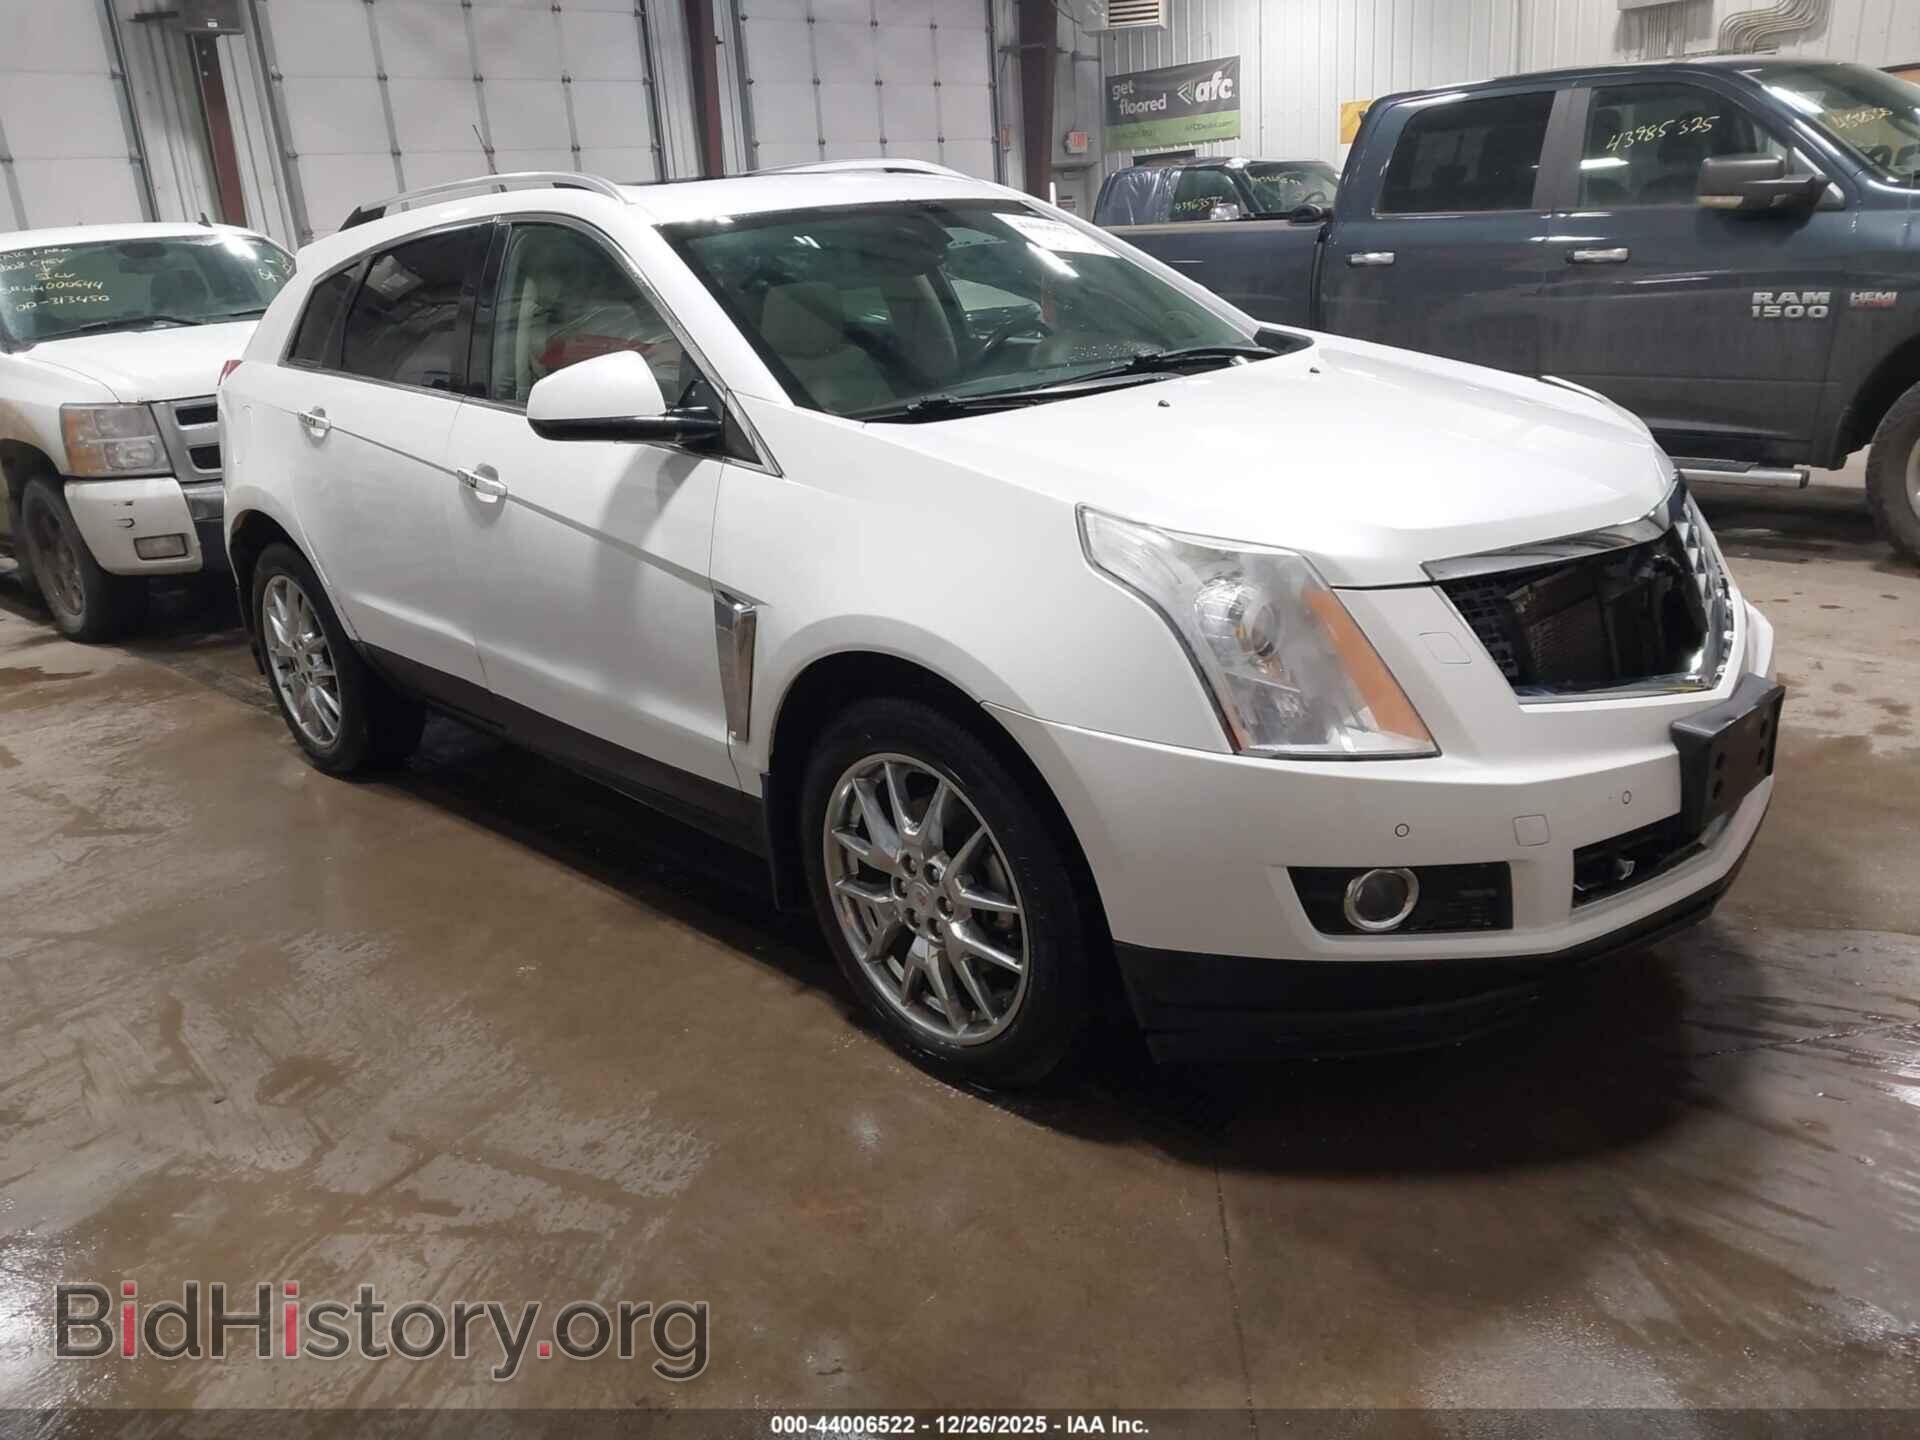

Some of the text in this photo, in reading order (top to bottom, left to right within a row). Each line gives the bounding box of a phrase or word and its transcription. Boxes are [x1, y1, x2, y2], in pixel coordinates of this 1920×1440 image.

[1112, 80, 1135, 101] get
[1195, 71, 1234, 103] afc
[1120, 93, 1167, 115] floored
[1752, 291, 1831, 304] RAM
[1850, 291, 1898, 305] HEMI
[1752, 305, 1829, 318] 1500
